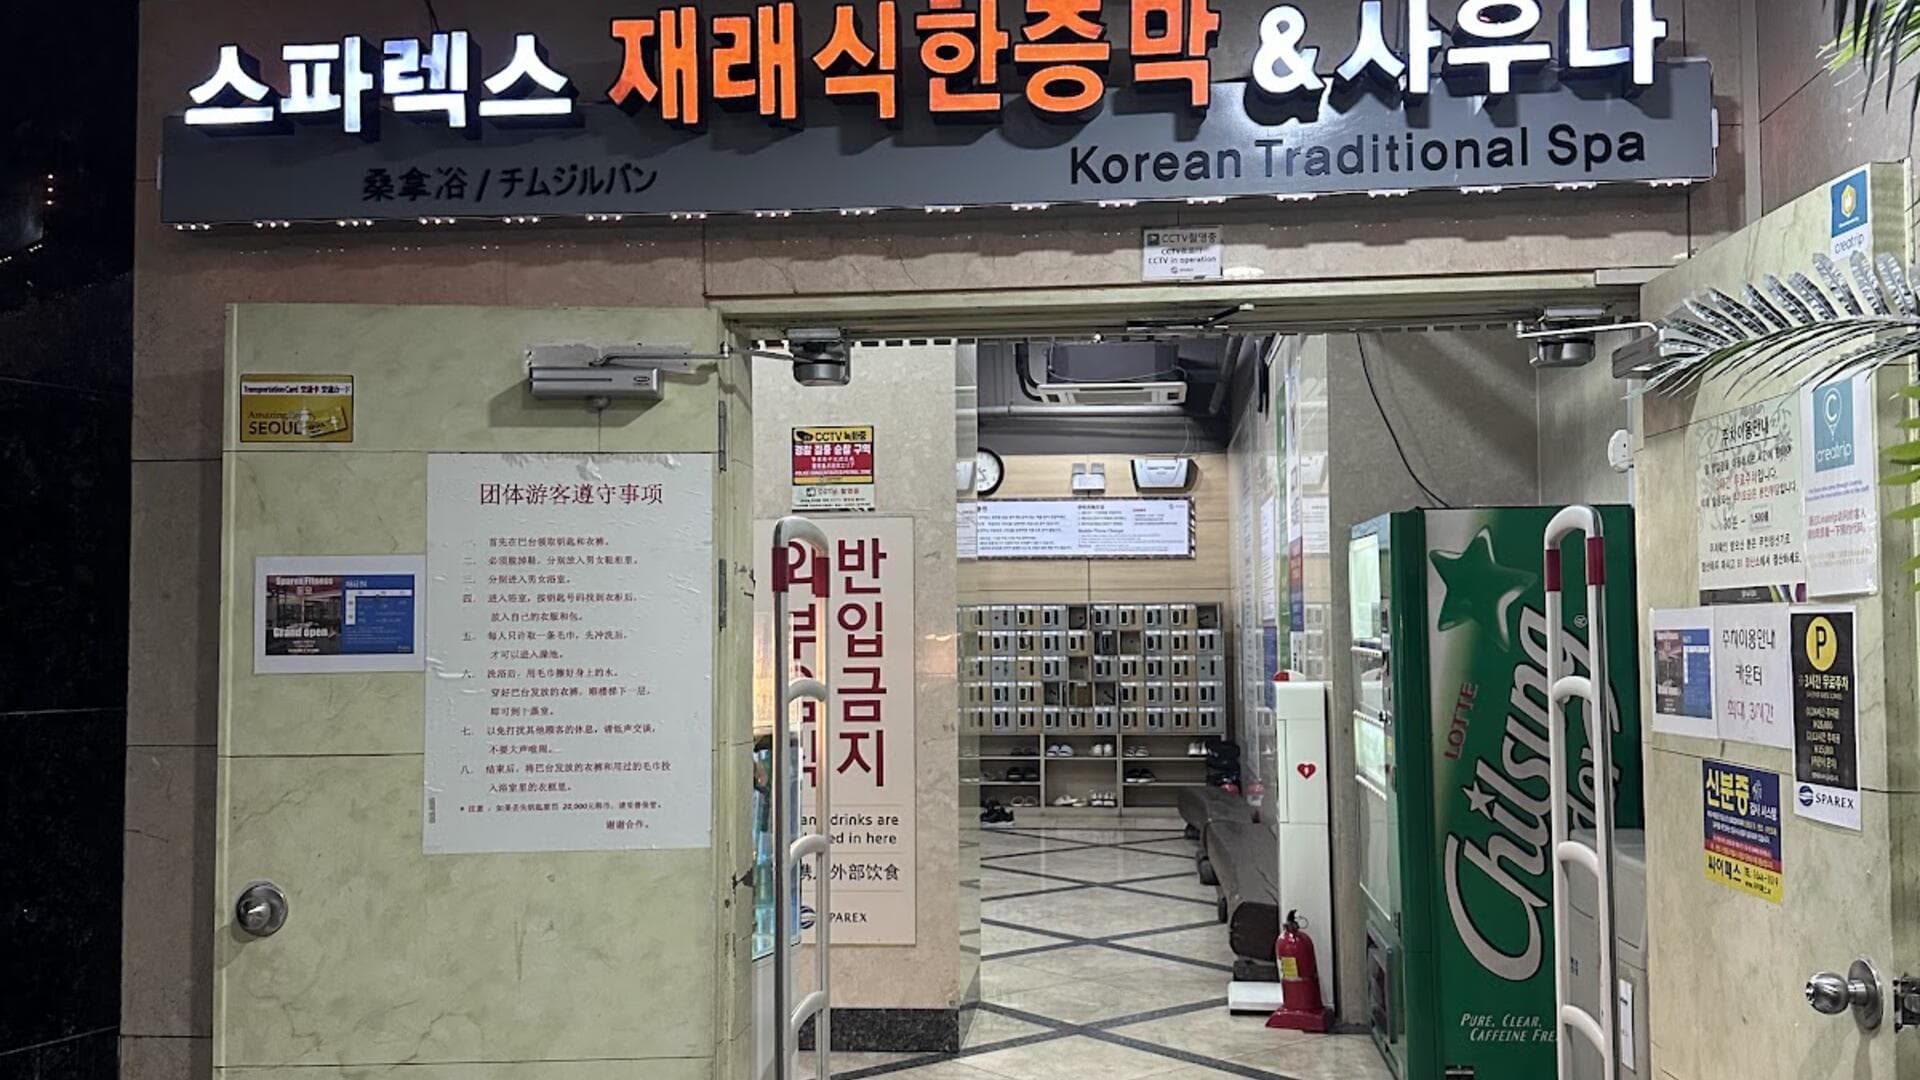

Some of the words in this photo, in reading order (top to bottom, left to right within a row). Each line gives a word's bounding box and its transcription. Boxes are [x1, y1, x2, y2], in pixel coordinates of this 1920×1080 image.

[185, 30, 573, 133] 스파렉스
[606, 0, 1220, 125] 재래식한증막
[1336, 0, 1668, 93] 사우나
[1071, 146, 1242, 186] Korean
[1254, 126, 1529, 179] Traditional
[1547, 123, 1648, 171] Spa
[248, 421, 303, 436] SEOUL
[815, 431, 842, 442] CCTV
[479, 482, 664, 506] 团体游客遵守事项
[303, 627, 330, 638] open
[1815, 625, 1828, 659] P
[836, 537, 888, 788] 반입금지
[1443, 680, 1479, 761] LOTTE
[1443, 605, 1620, 982] Chilsung
[1705, 767, 1750, 817] 신분증
[1815, 792, 1855, 809] SPAREX
[830, 812, 873, 827] drinks
[877, 815, 899, 826] are
[848, 832, 862, 844] in
[865, 831, 897, 845] here
[1460, 1012, 1496, 1028] PURE.
[1469, 1027, 1528, 1042] CAFFEINE
[1532, 1028, 1557, 1042] FRE
